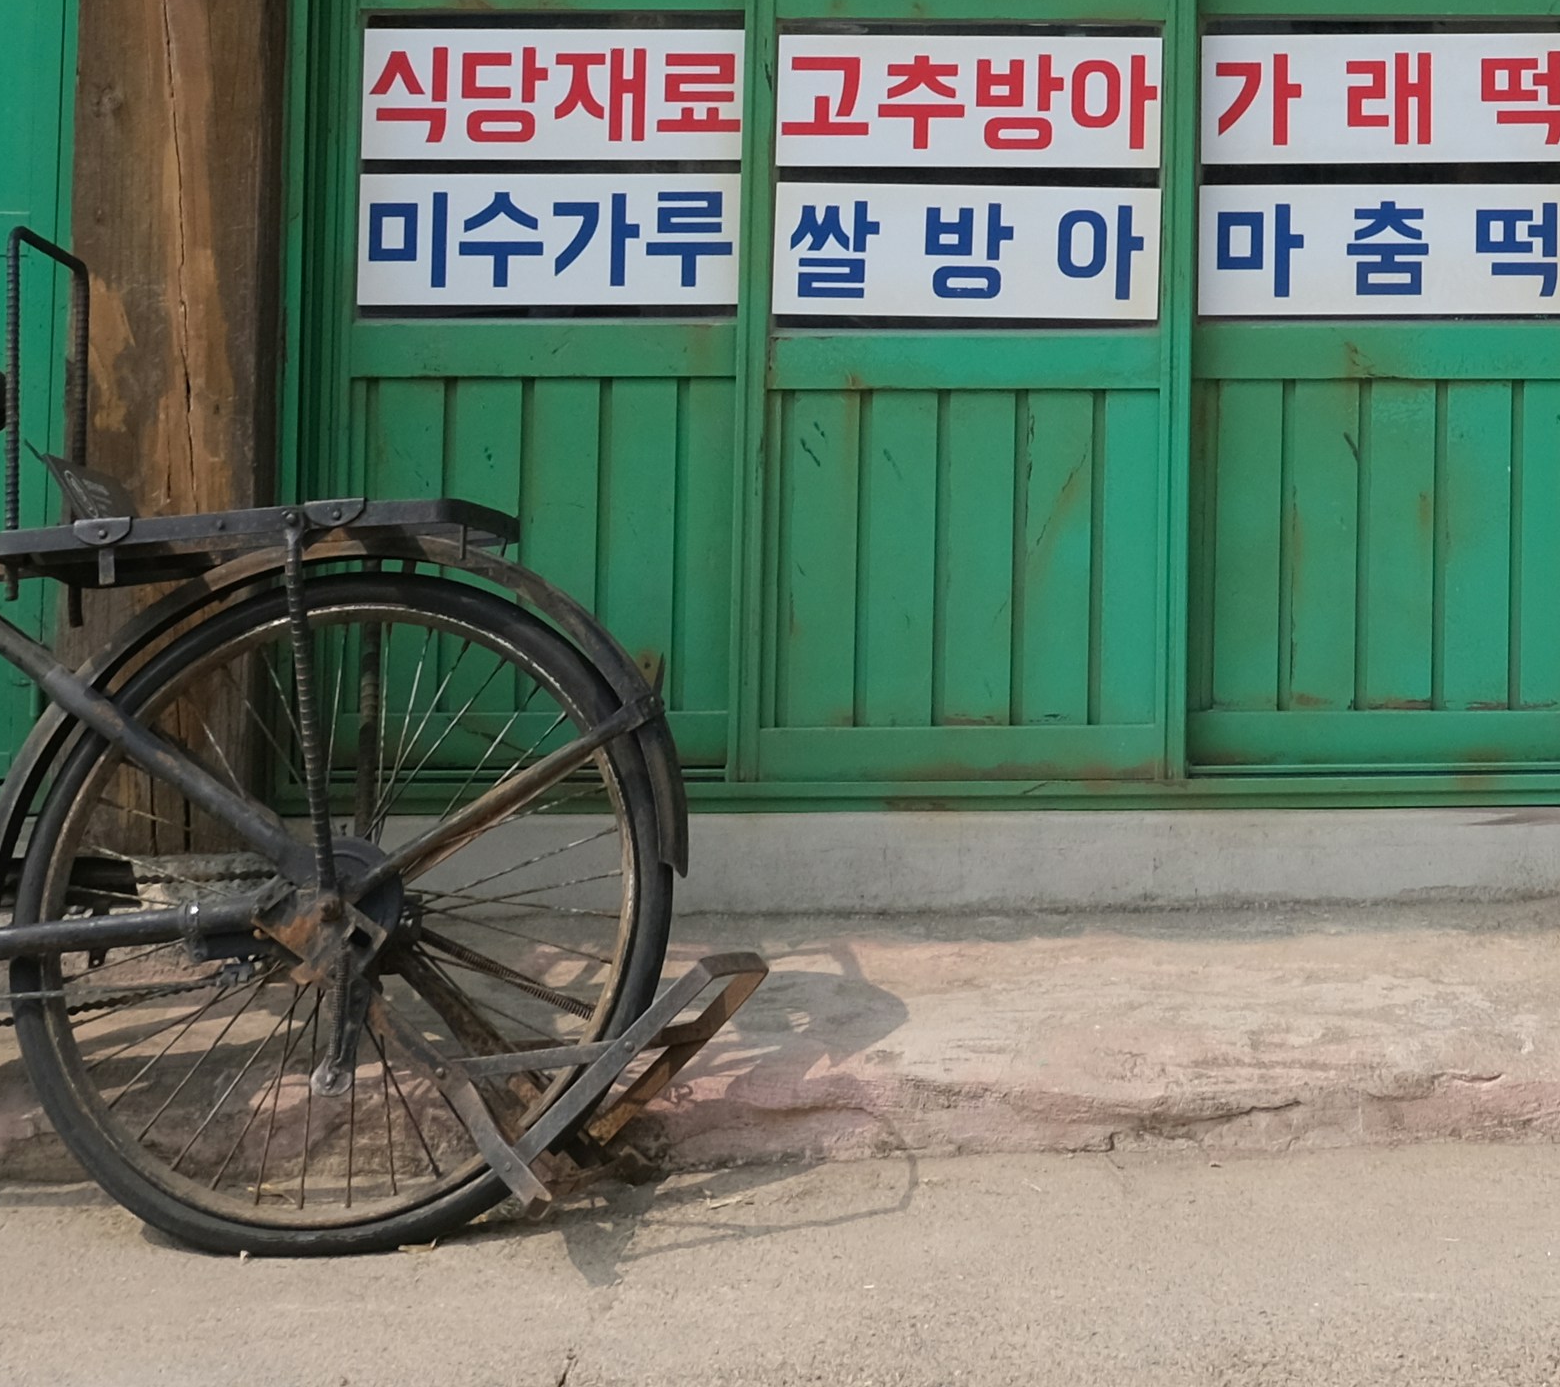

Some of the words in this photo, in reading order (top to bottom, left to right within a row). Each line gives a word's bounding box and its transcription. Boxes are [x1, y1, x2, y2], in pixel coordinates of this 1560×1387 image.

[368, 46, 742, 144] 식당재료
[781, 52, 1159, 151] 고추방아
[369, 190, 734, 290] 미수가루
